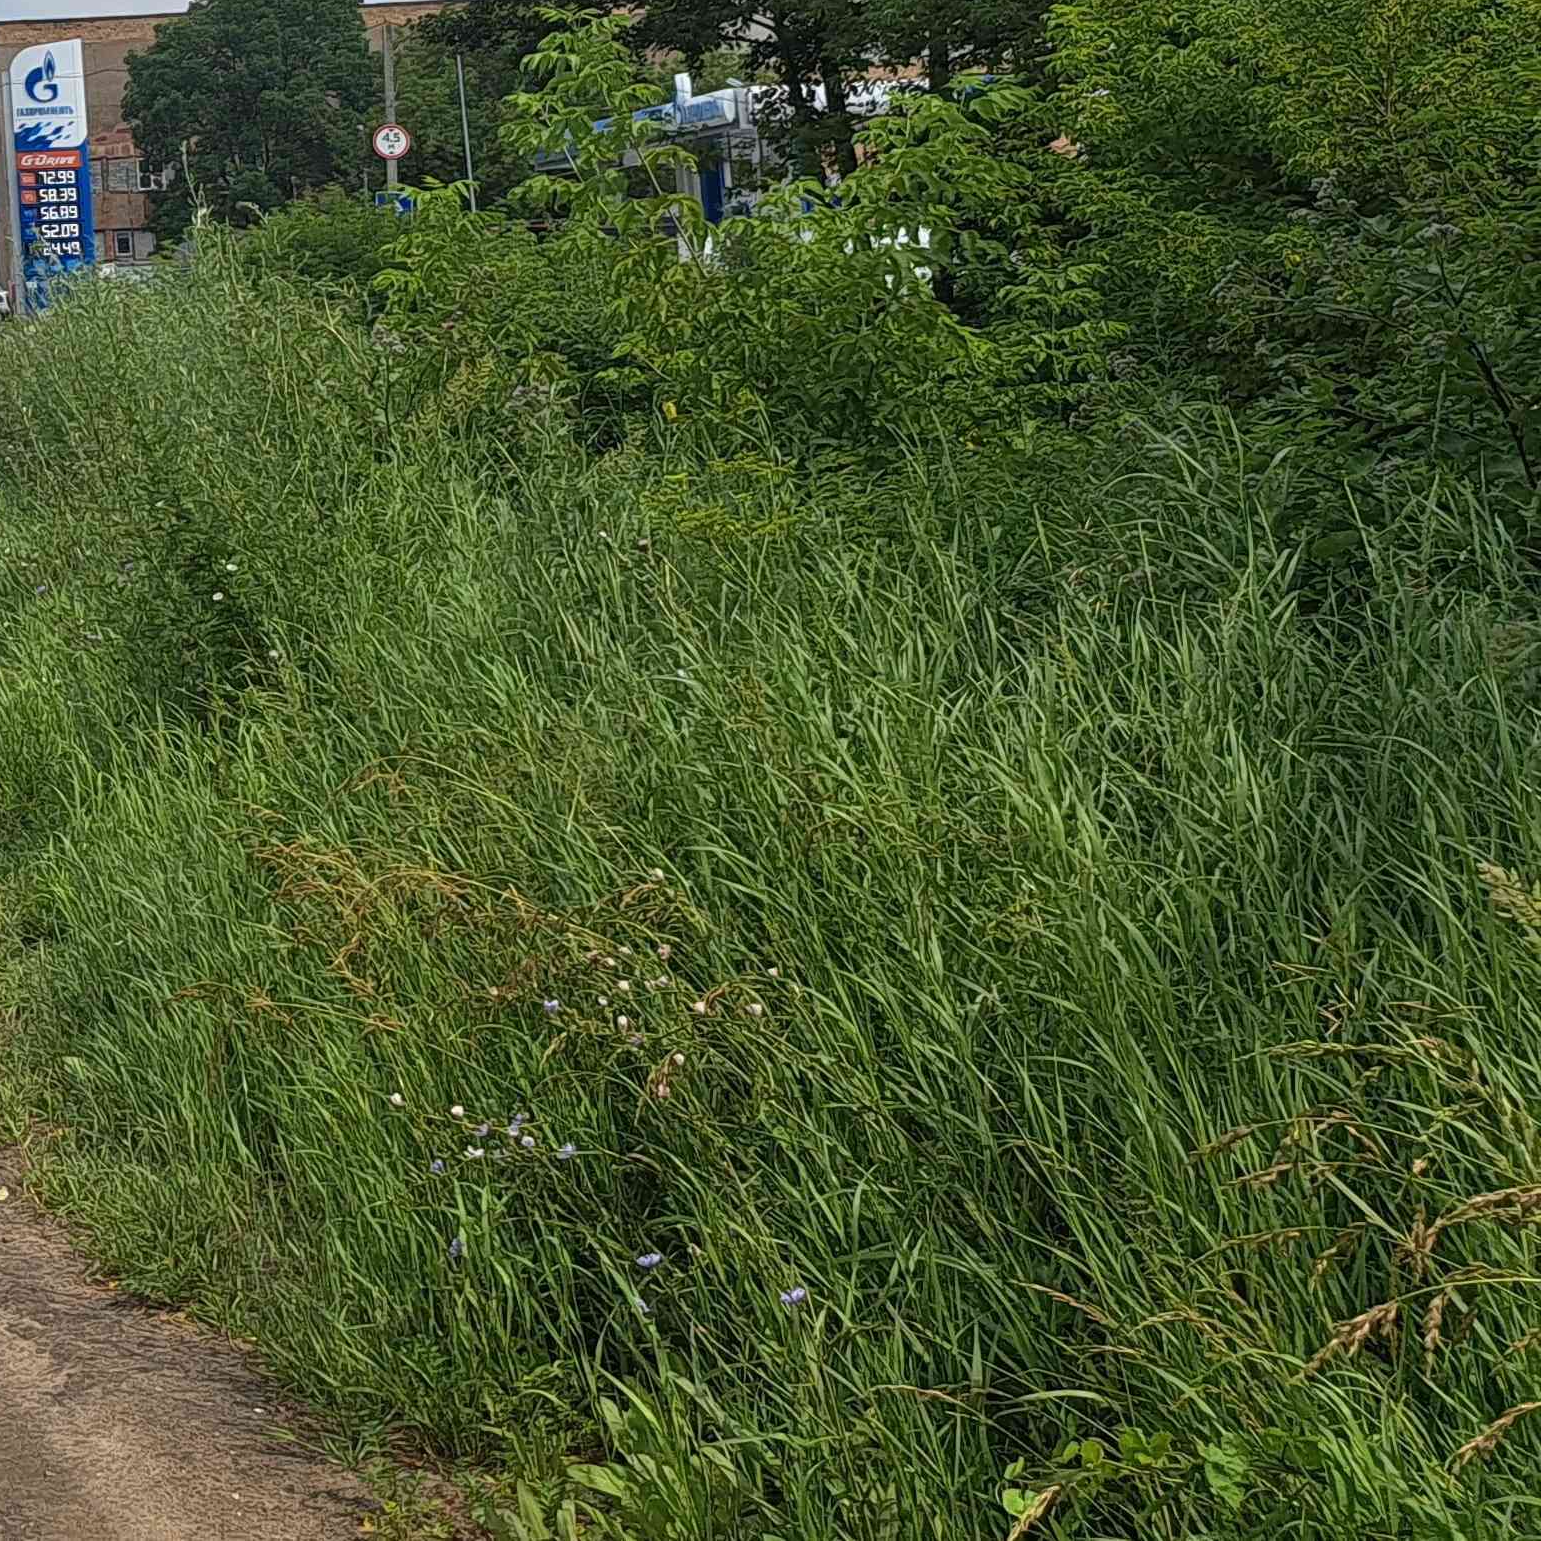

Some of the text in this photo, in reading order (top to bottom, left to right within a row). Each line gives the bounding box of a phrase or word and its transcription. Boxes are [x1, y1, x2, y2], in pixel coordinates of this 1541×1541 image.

[39, 170, 76, 184] 72.99
[39, 187, 77, 202] 58.39
[41, 223, 79, 238] 52.09
